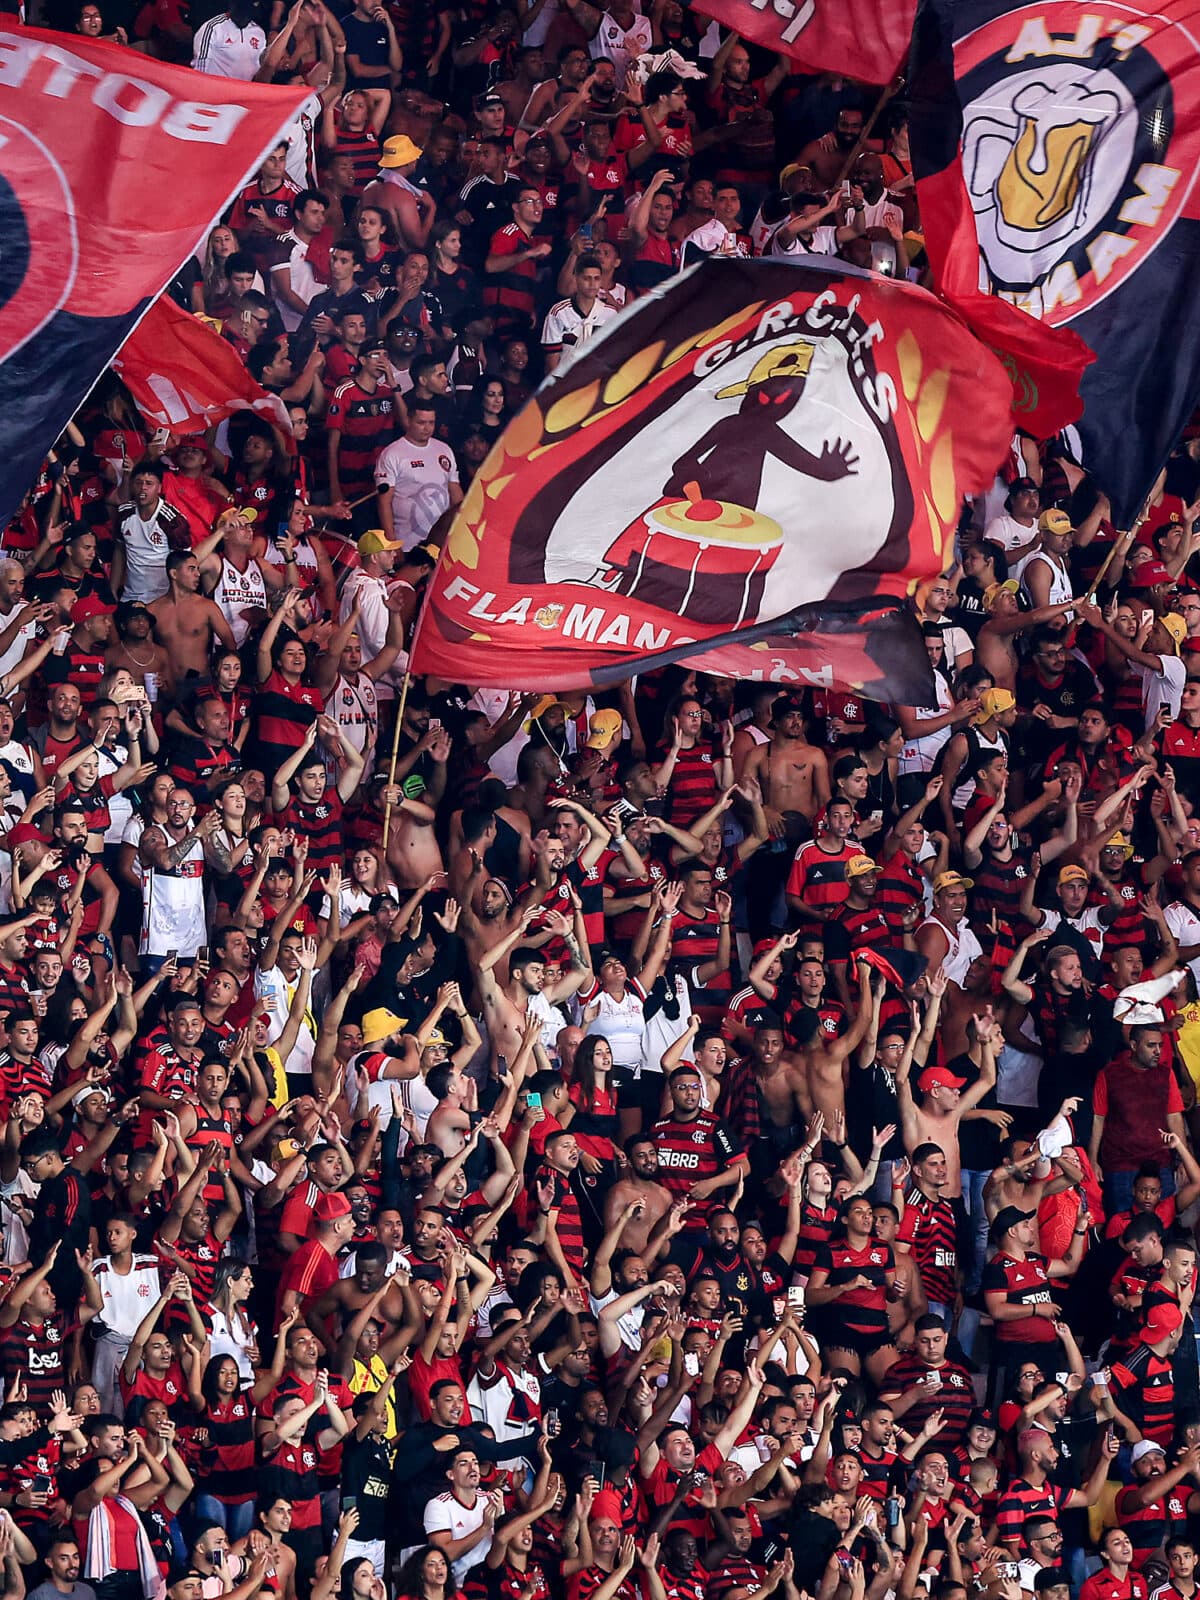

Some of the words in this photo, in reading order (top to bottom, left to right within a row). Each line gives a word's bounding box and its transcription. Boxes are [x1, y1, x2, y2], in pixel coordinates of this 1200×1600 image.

[442, 575, 533, 626] FLA
[717, 1129, 733, 1154] HAVAN
[671, 1153, 699, 1168] BRB
[28, 1347, 61, 1369] bs2
